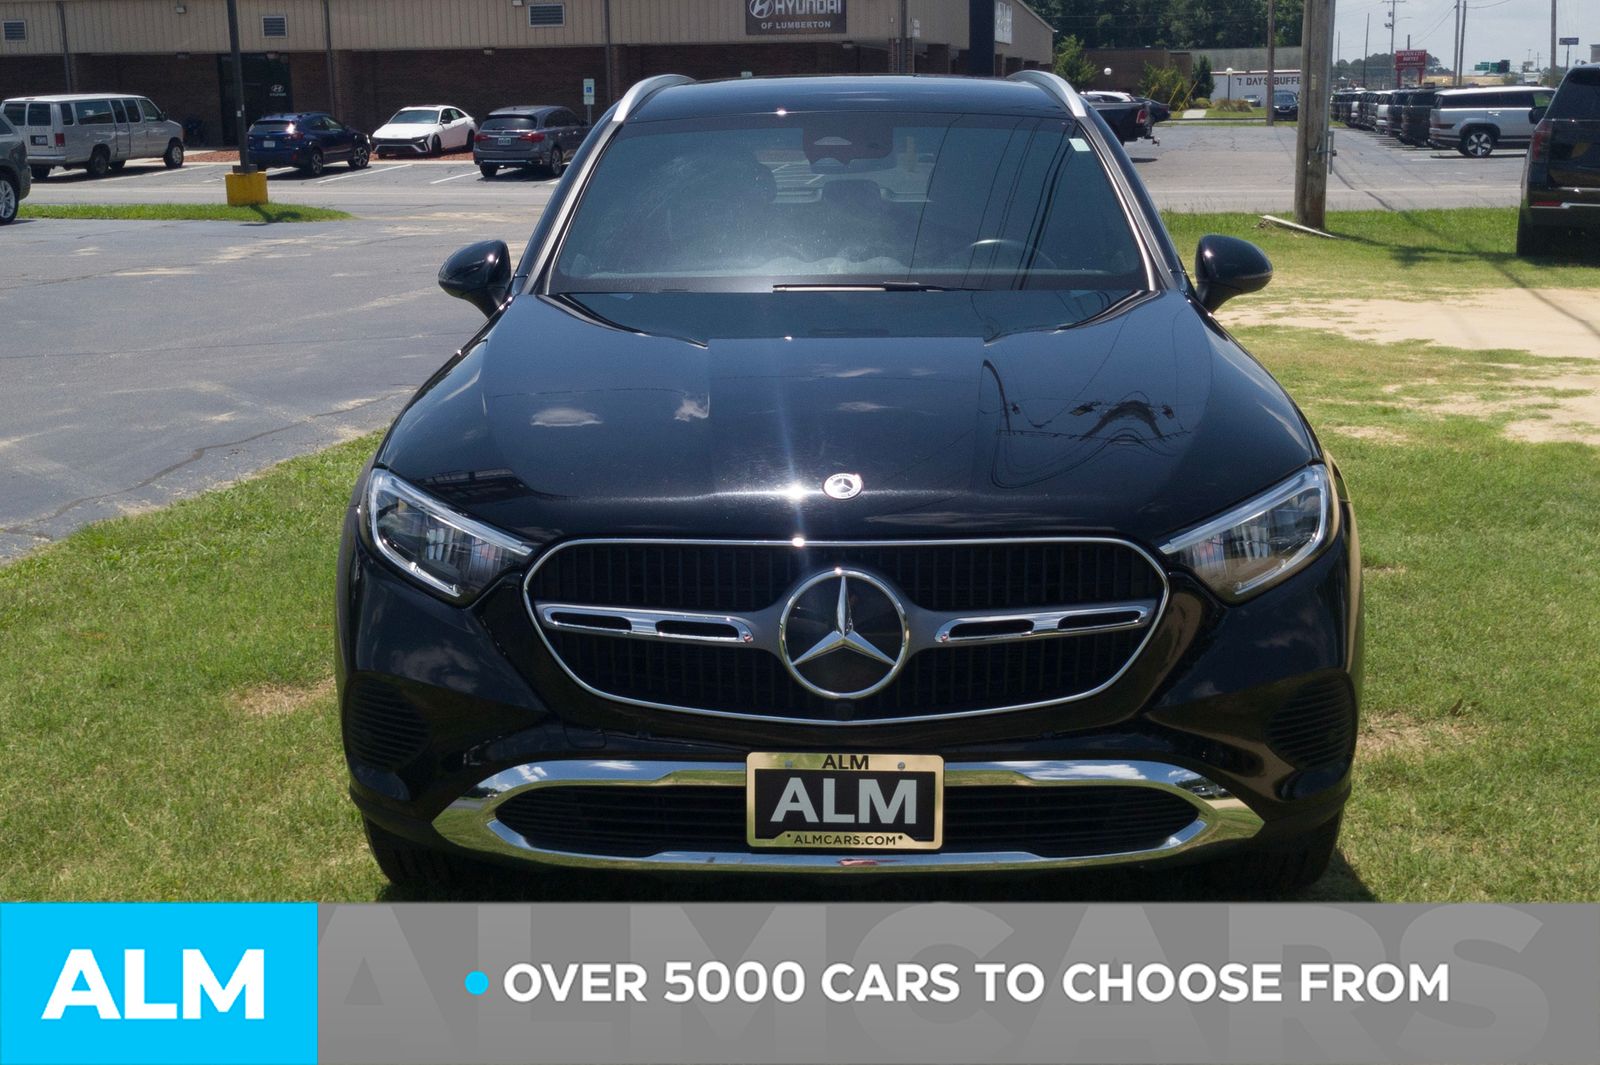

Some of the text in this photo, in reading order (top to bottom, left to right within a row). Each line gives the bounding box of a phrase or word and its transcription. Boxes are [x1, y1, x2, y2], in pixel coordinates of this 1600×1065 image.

[775, 0, 841, 16] HYUNDAI
[761, 20, 831, 30] OF LUMBERTON
[1236, 76, 1301, 86] 7 DAYS BUFFE
[822, 754, 869, 770] ALM
[770, 777, 917, 825] ALM
[794, 835, 896, 846] ALMCARS.COM
